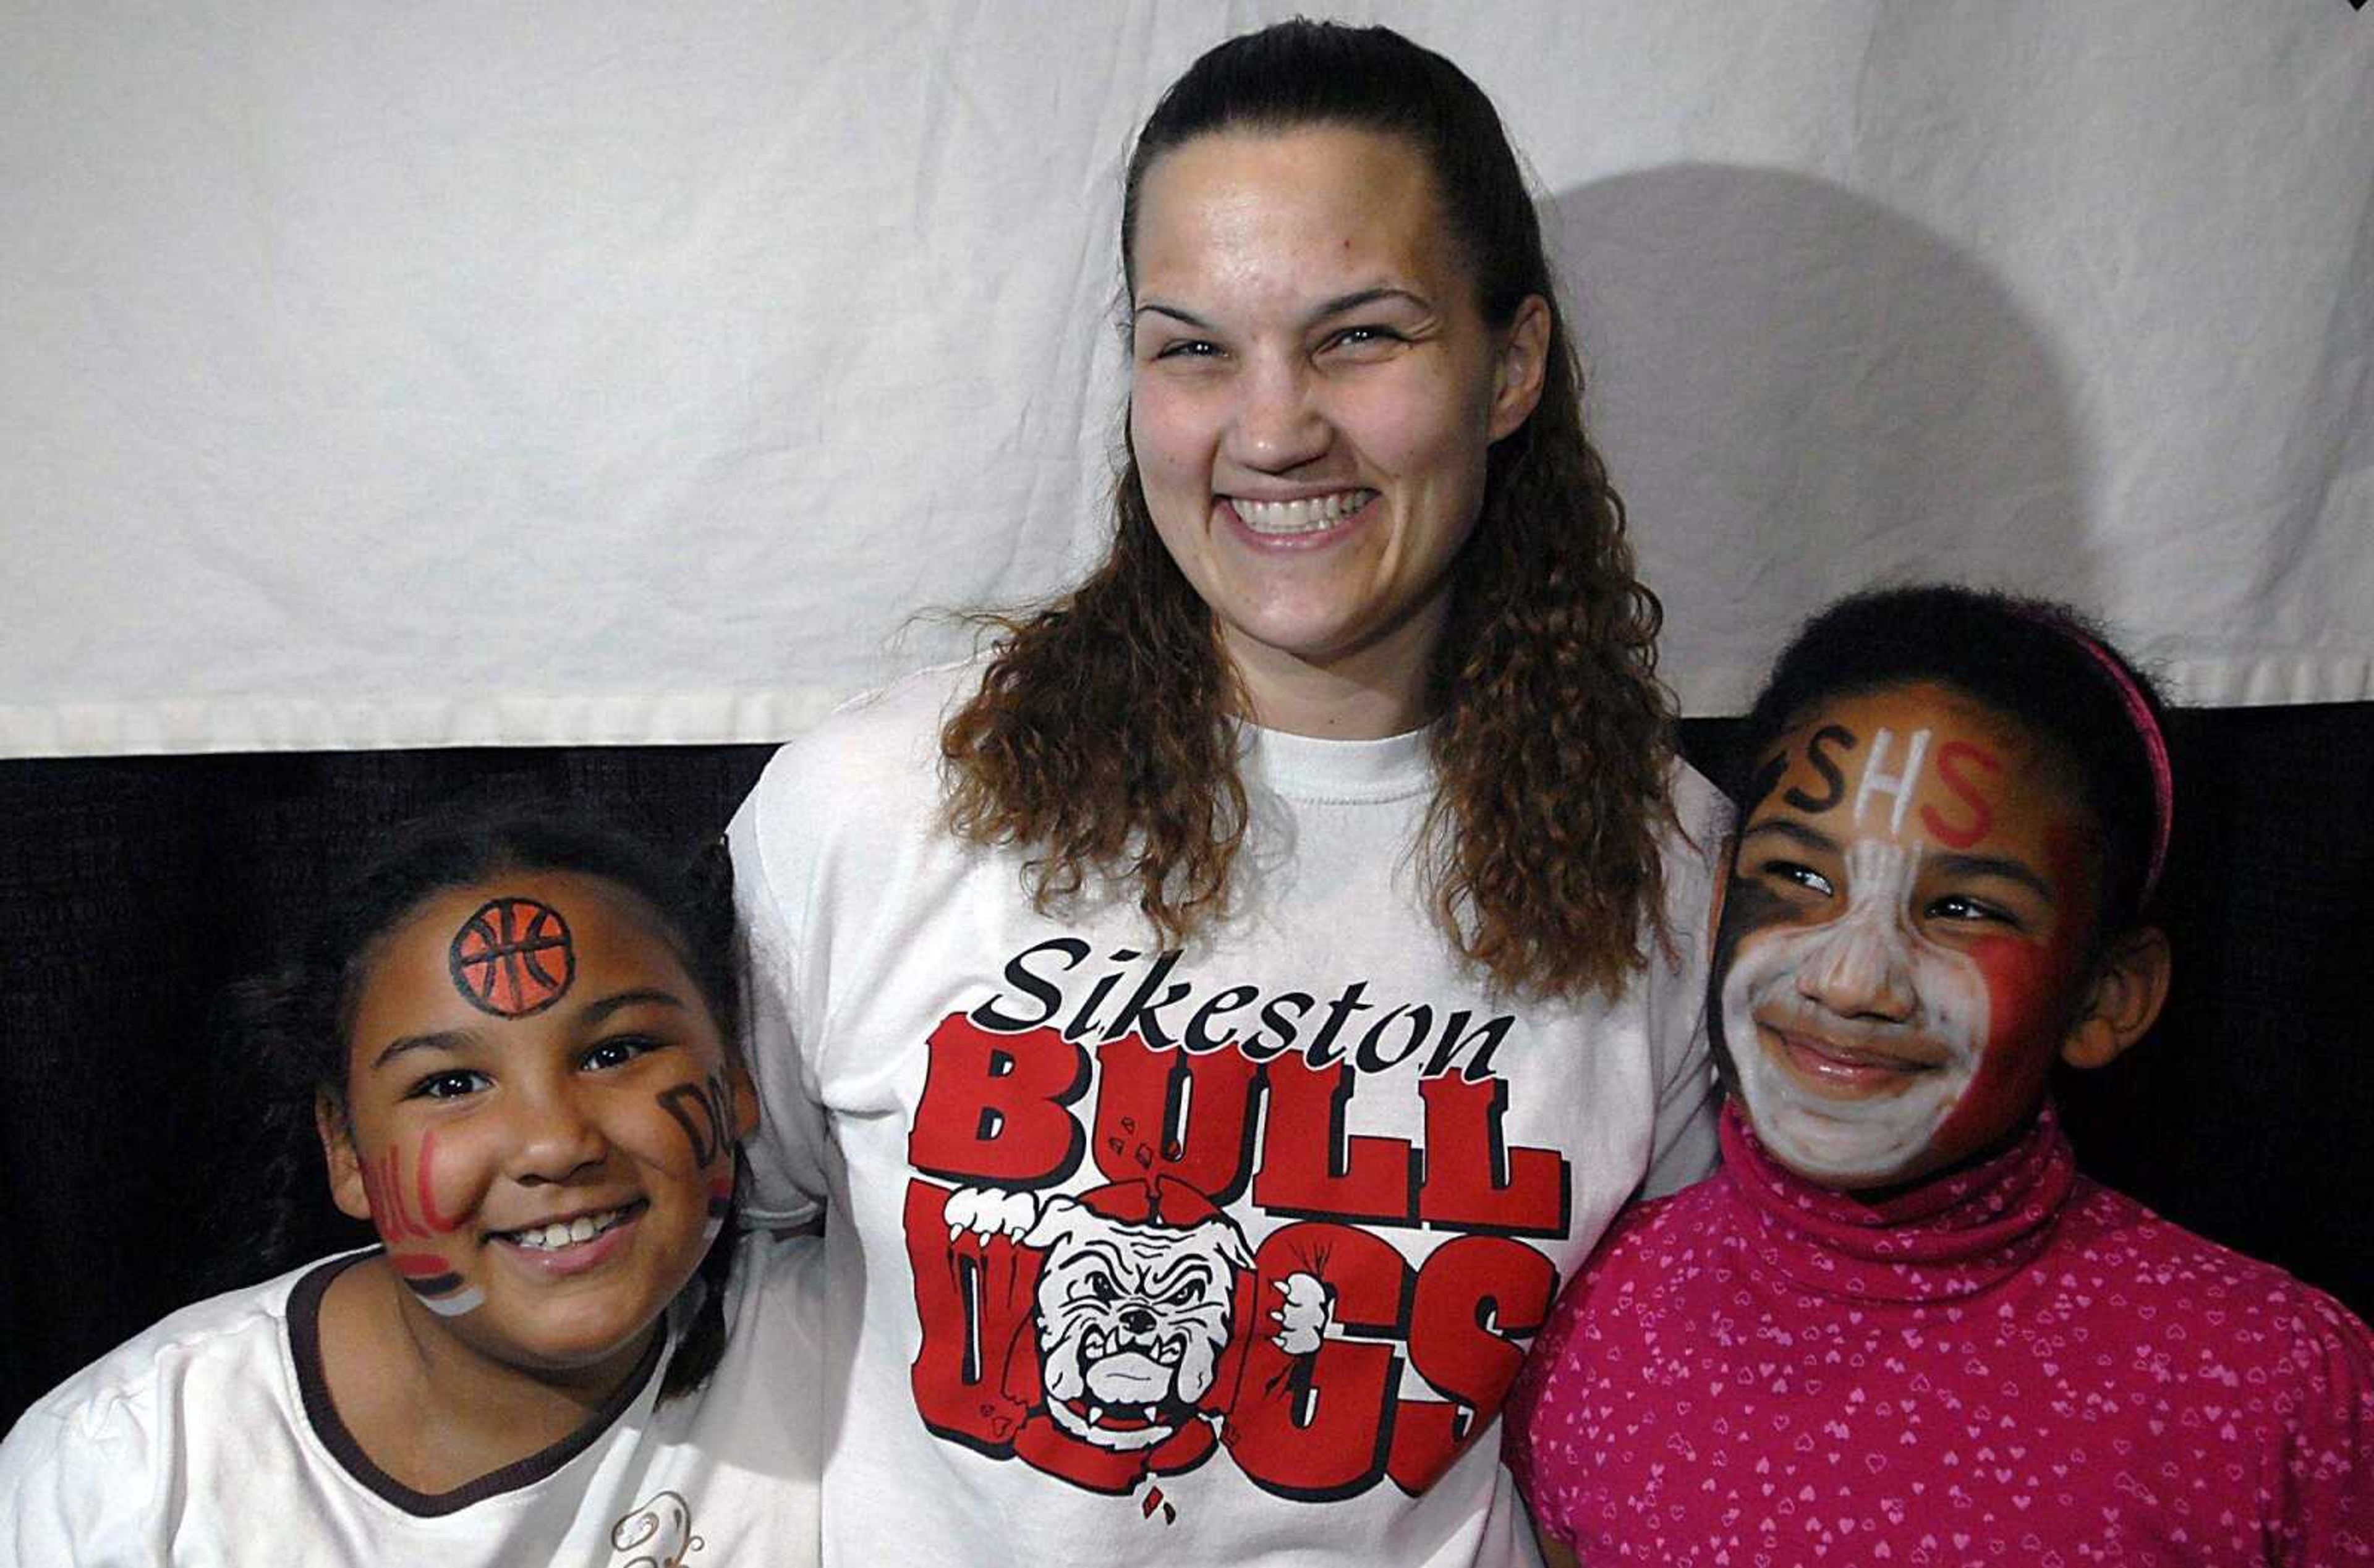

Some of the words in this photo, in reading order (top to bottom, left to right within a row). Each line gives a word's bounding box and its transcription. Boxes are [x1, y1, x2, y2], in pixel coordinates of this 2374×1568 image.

[971, 937, 1516, 1078] Sikeston
[908, 1012, 1571, 1238] BULL
[903, 1177, 1560, 1502] DOGS
